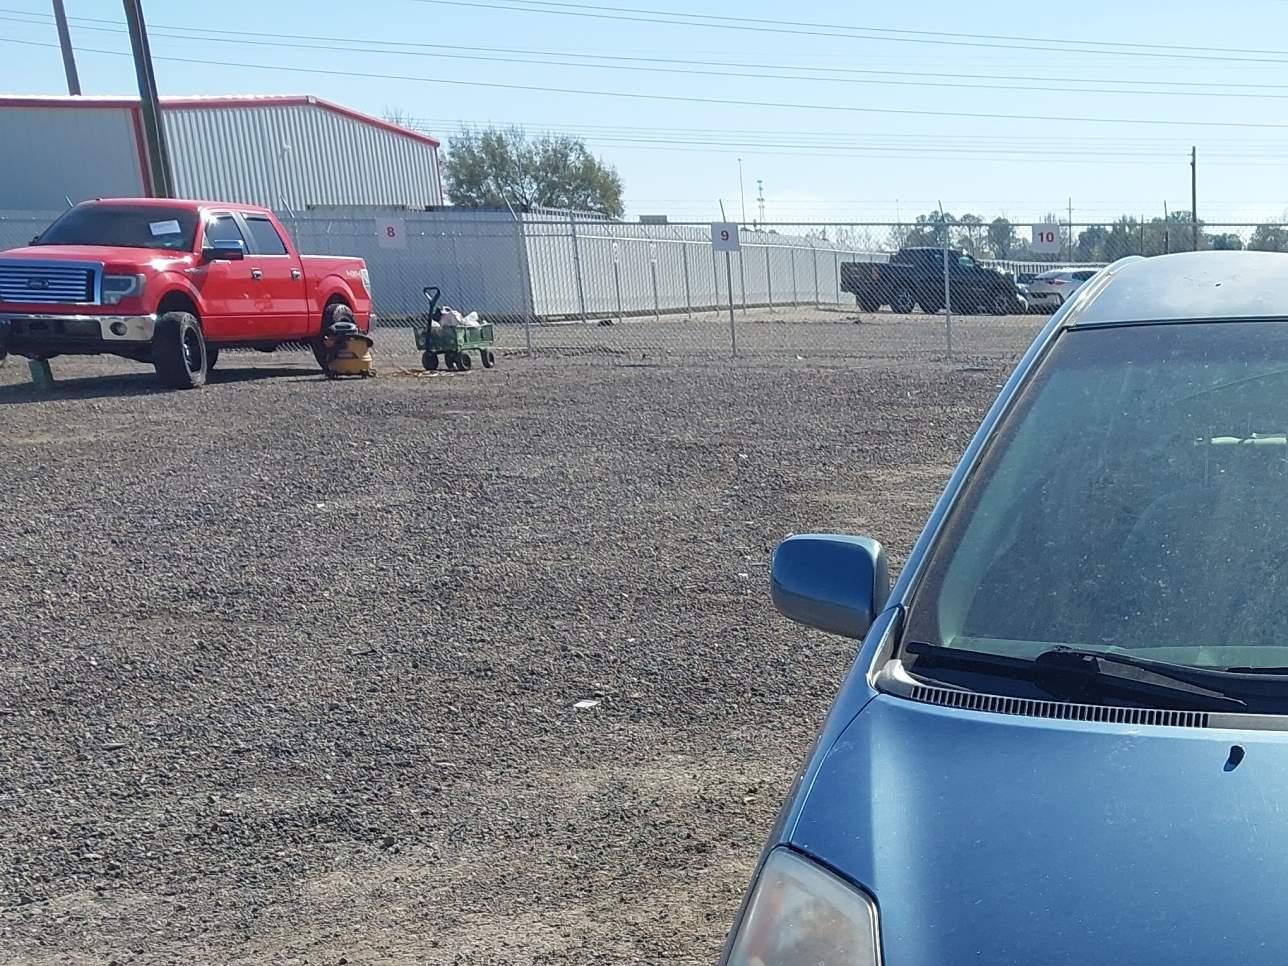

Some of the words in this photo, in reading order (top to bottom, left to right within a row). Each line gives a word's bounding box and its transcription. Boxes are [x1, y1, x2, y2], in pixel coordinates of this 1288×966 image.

[386, 226, 396, 238] 8
[720, 230, 730, 241] 9
[1038, 231, 1055, 243] 10
